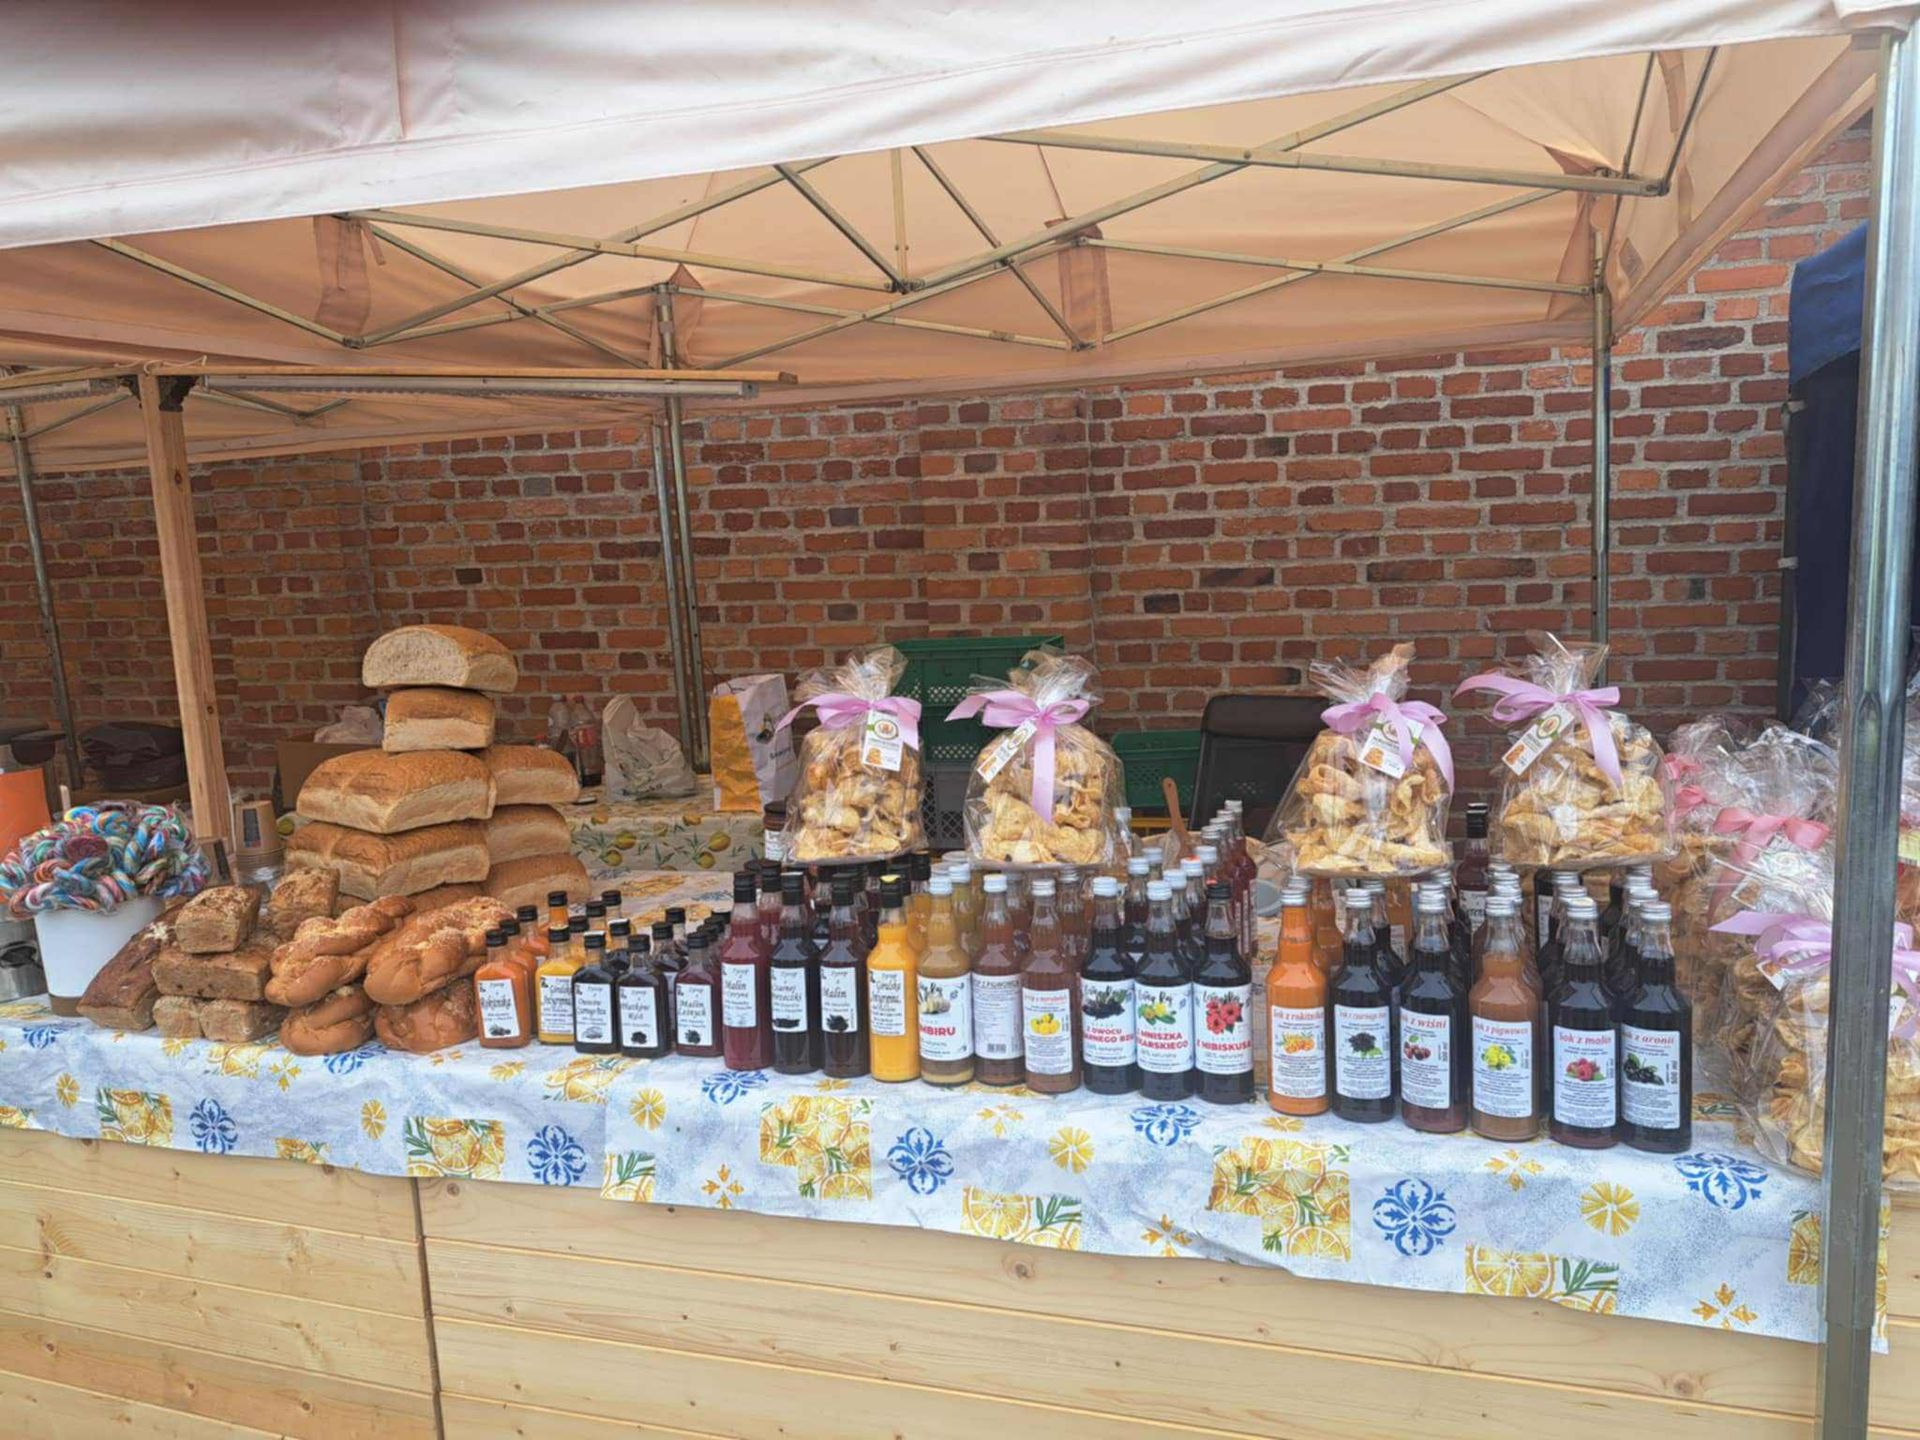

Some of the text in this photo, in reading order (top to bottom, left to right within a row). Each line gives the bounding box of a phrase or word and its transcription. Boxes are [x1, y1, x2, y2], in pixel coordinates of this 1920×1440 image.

[1417, 1018, 1447, 1029] wiśni
[919, 1026, 956, 1037] MBIRU
[1092, 1027, 1122, 1035] OWOCU
[1141, 1030, 1182, 1041] MNISZKA
[1559, 1031, 1575, 1043] Sok
[1642, 1035, 1674, 1043] aronii
[1136, 1039, 1188, 1050] KARSKIEGO
